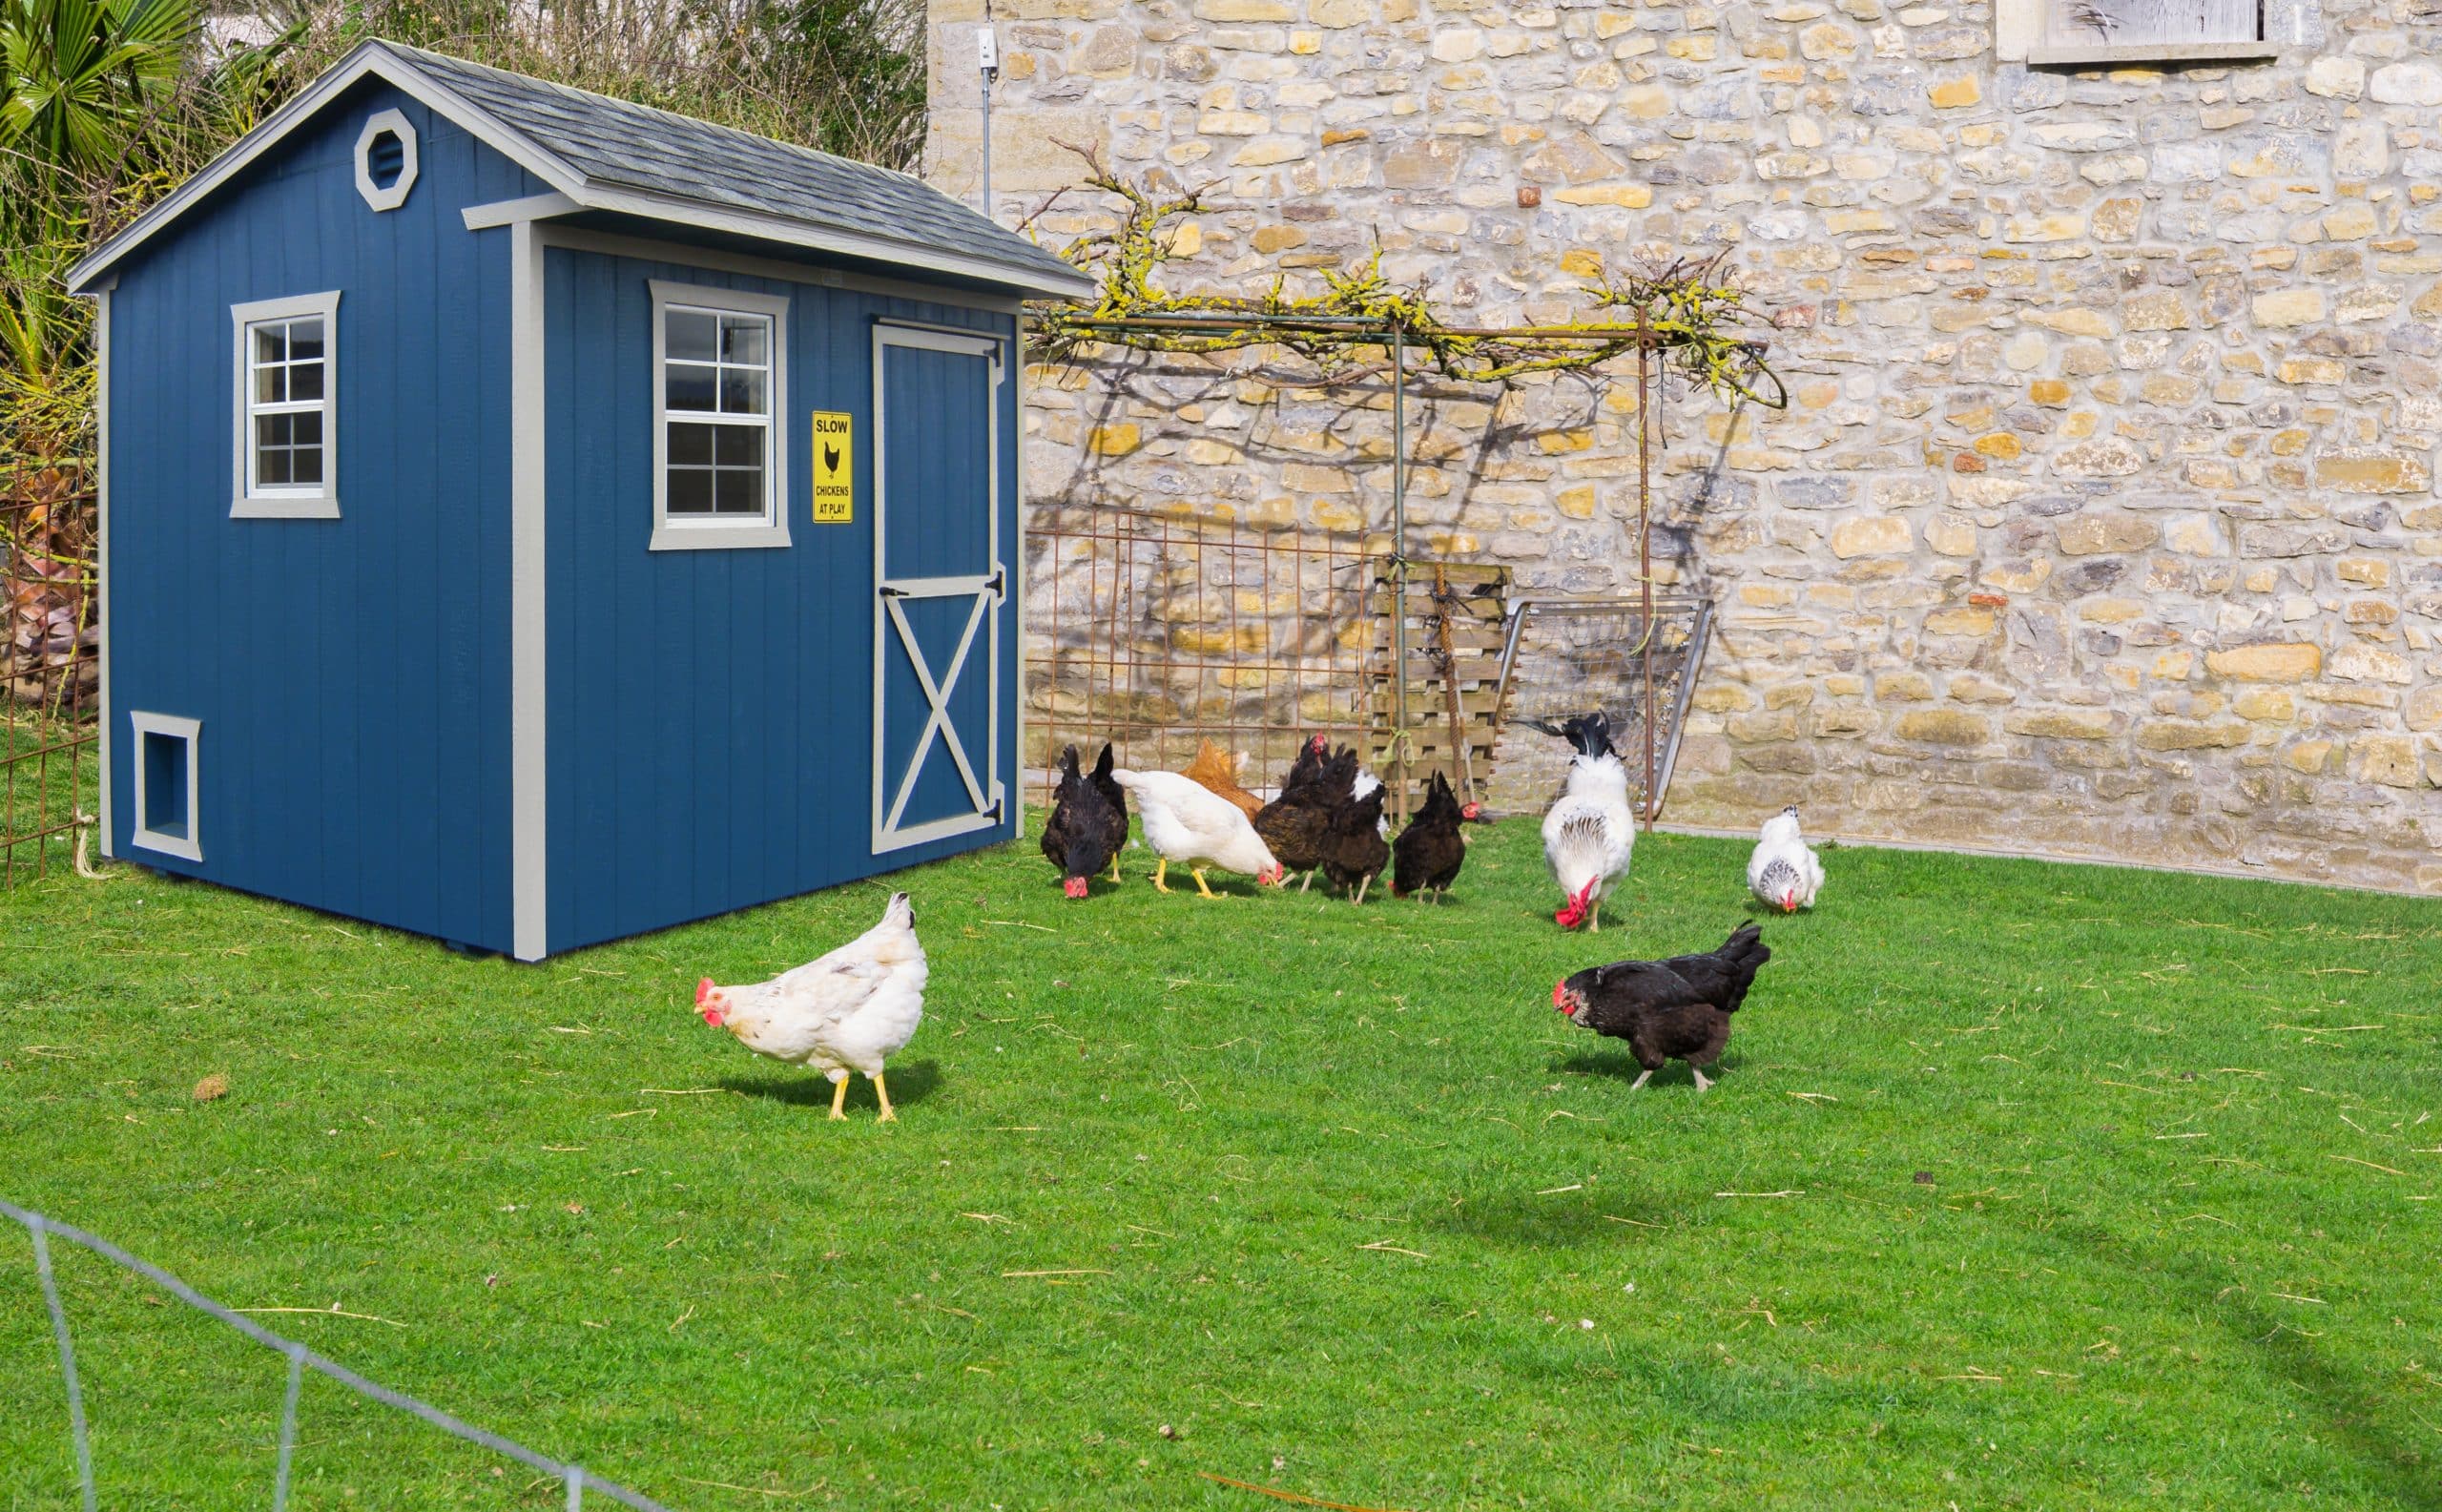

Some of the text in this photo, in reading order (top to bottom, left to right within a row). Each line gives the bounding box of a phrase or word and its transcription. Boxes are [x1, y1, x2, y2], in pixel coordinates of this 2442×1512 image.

[817, 420, 847, 433] SLOW
[817, 486, 848, 496] CHICKENS
[819, 504, 845, 514] AT PLAY
